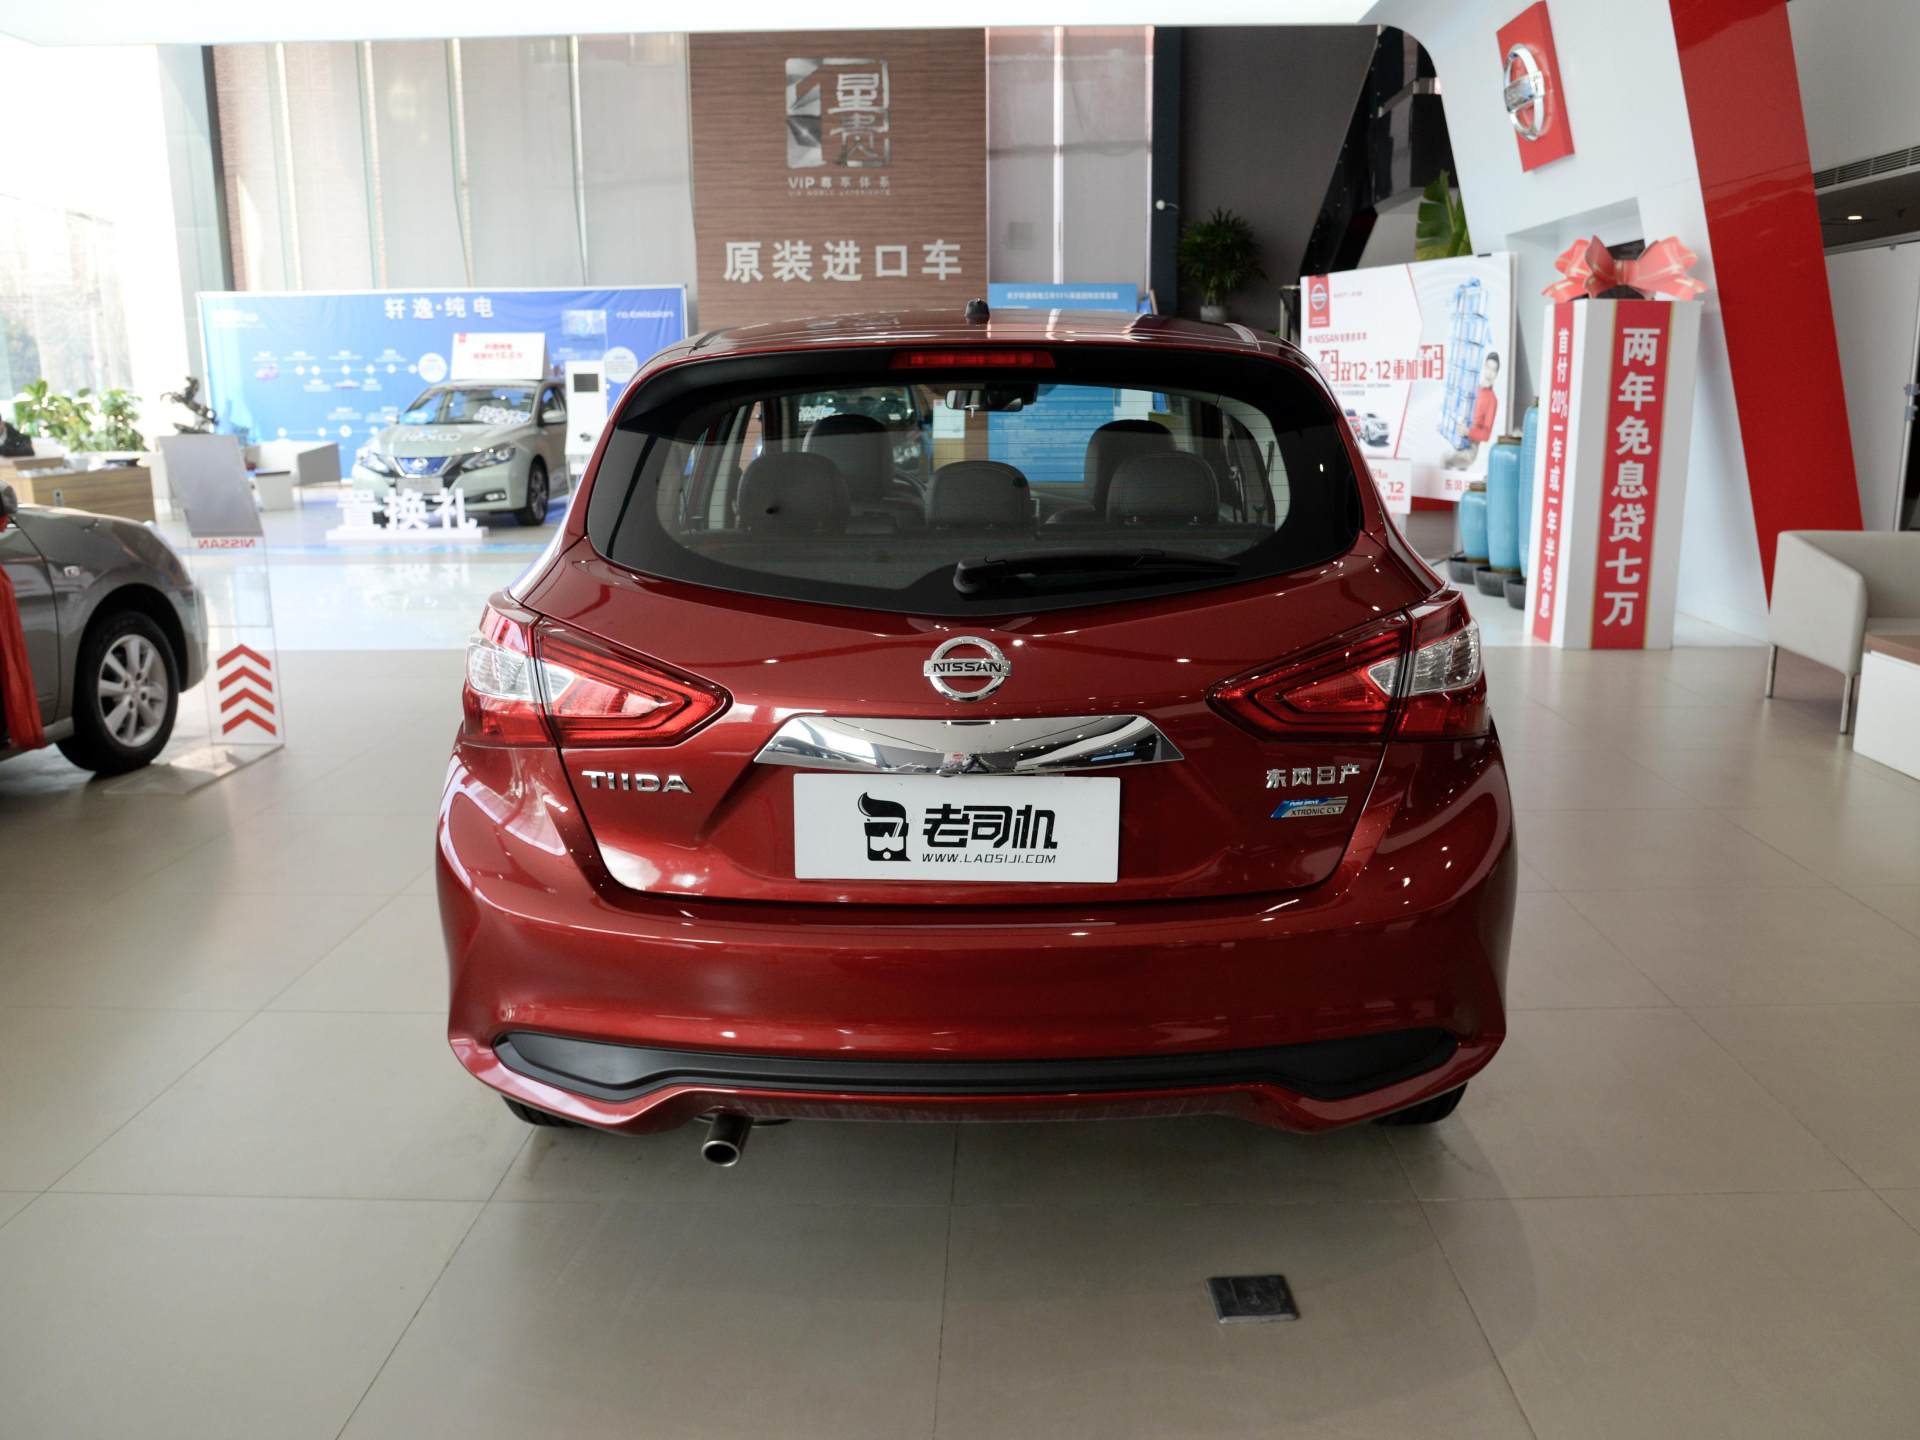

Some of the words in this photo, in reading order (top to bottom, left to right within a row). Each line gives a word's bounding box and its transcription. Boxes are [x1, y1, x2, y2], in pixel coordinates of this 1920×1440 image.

[788, 176, 815, 189] VIP
[723, 239, 963, 283] 原装进口车
[384, 297, 494, 320] 轩逸·纯电
[1602, 327, 1661, 627] 两年免息贷七万
[336, 487, 477, 529] 置换礼
[933, 662, 1002, 673] NISSAN
[582, 770, 692, 793] TIIDA
[1266, 764, 1360, 788] 东风日产
[1291, 807, 1326, 816] XTRONIC
[1326, 806, 1343, 814] CVT
[923, 803, 1058, 848] 老司机
[922, 853, 1057, 863] WWW.LAOSIJI.COM
